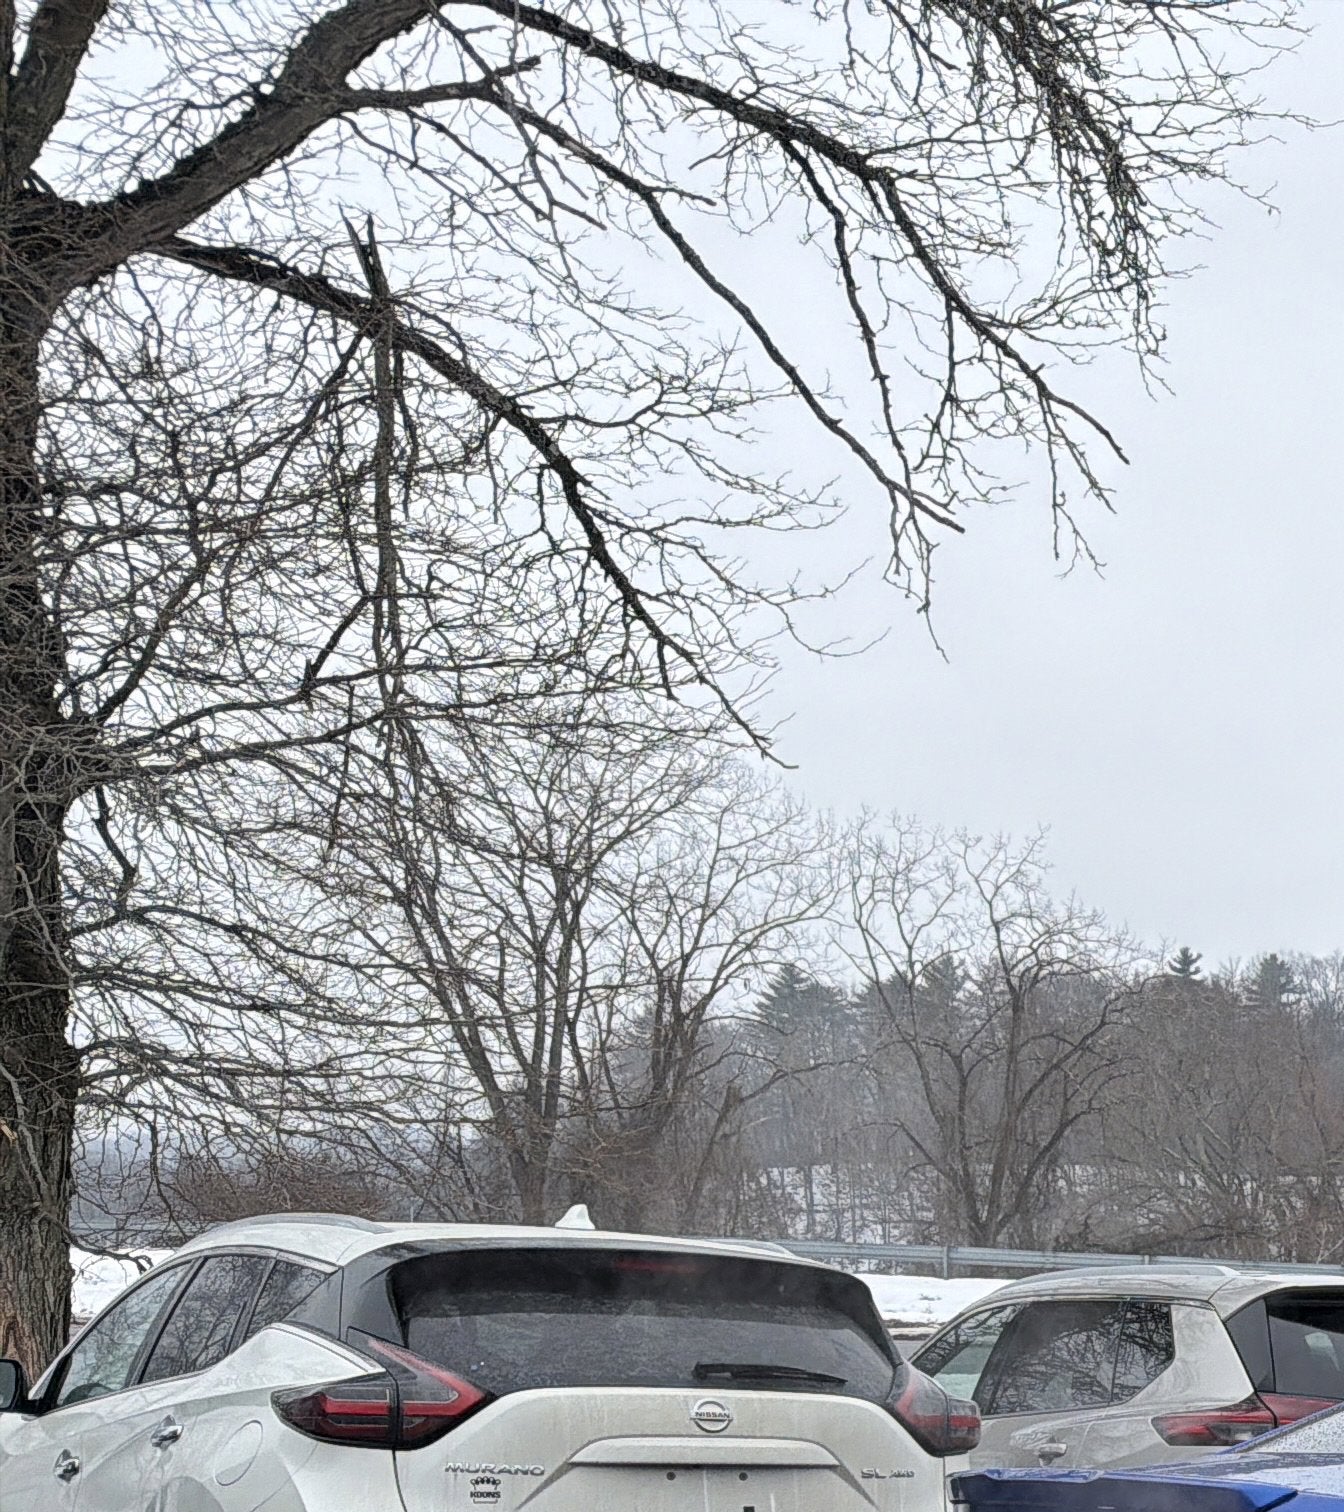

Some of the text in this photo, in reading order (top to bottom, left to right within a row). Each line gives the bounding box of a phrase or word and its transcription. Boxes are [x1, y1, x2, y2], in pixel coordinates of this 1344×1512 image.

[445, 1462, 545, 1476] MURANO
[861, 1468, 887, 1479] SL
[470, 1491, 501, 1499] KOONS
